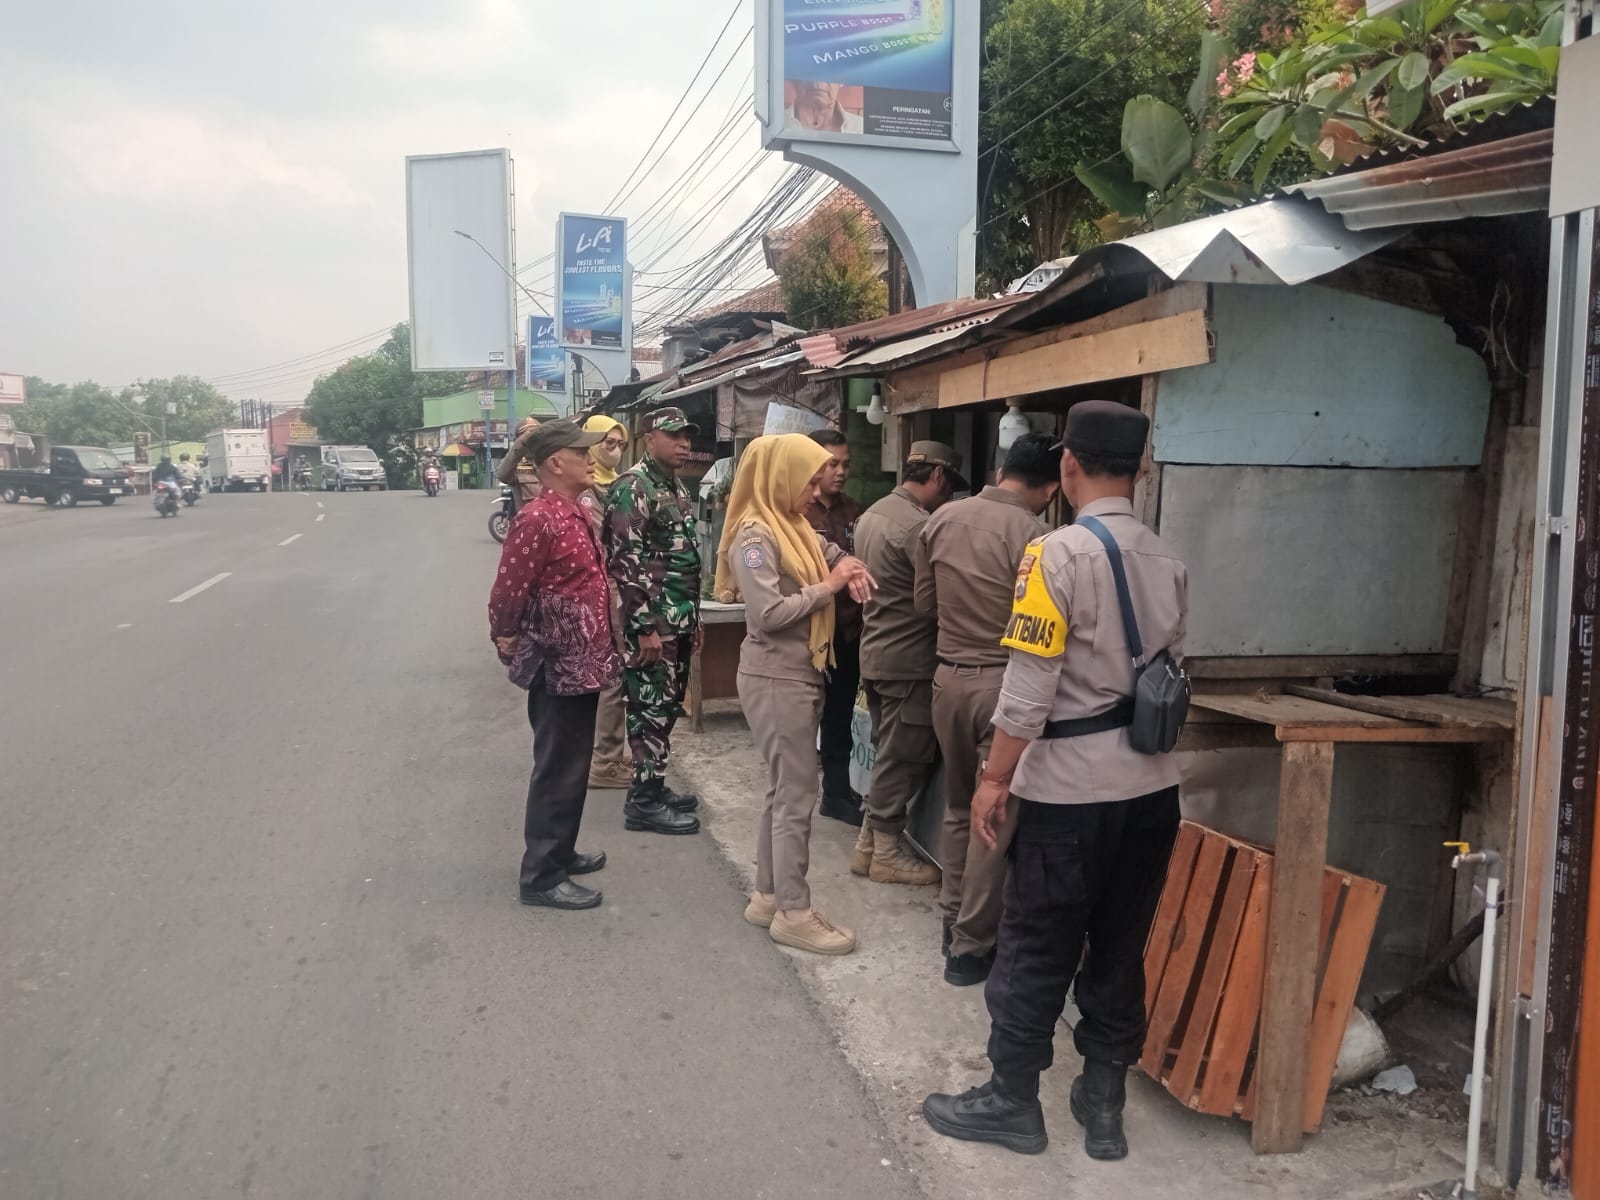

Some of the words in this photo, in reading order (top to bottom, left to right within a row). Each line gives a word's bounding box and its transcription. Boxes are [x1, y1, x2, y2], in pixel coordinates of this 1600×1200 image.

[784, 19, 858, 34] PURPLE
[862, 17, 892, 25] BOOST
[812, 44, 879, 64] MANGO
[882, 37, 913, 49] BOOST
[1563, 803, 1573, 825] 14001
